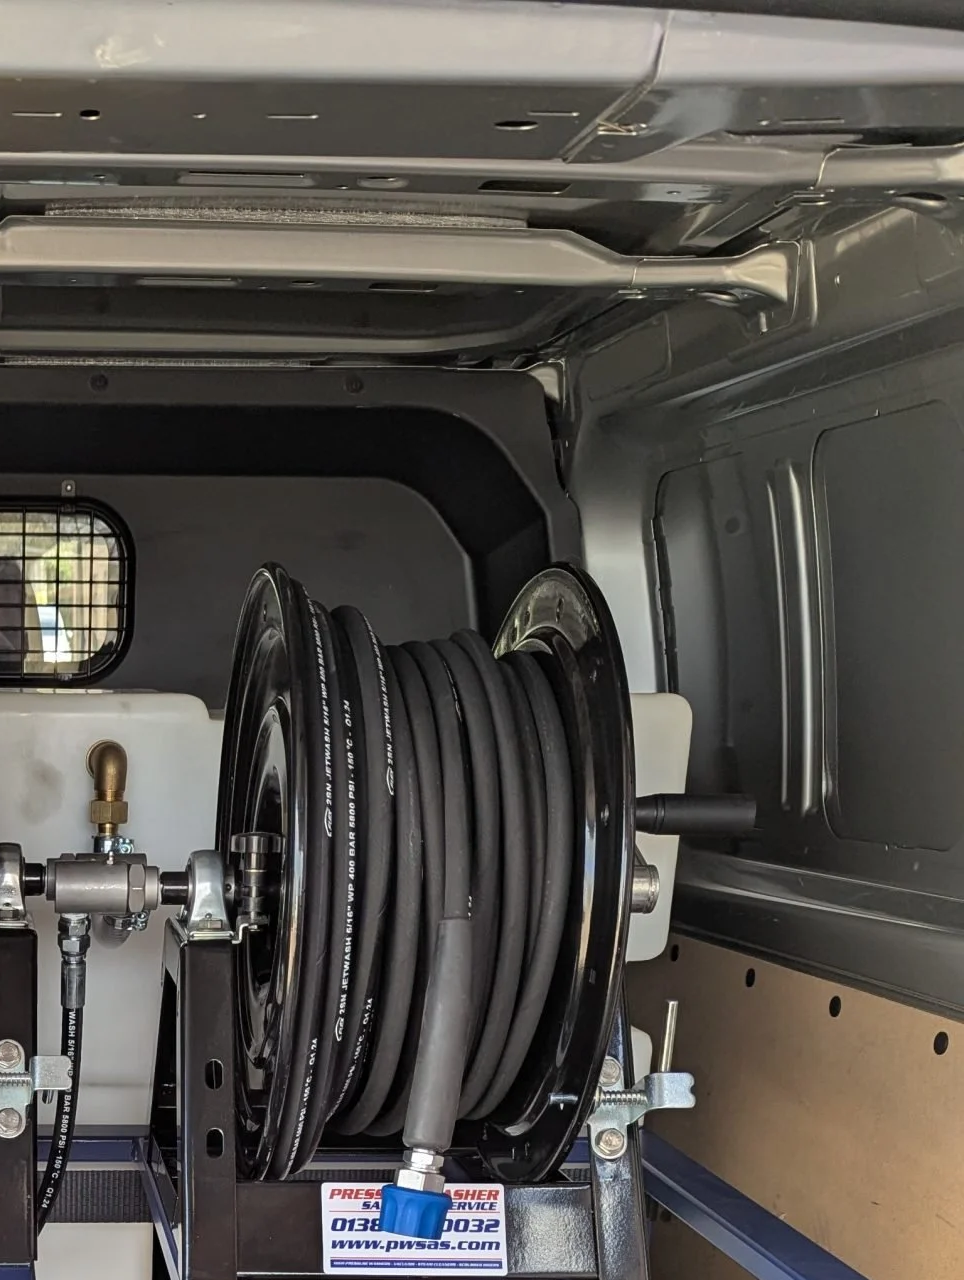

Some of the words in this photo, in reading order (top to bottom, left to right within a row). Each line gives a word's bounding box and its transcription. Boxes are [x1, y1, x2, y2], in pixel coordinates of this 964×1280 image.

[381, 693, 393, 742] JETWASH
[323, 727, 333, 781] JETWASH
[347, 752, 355, 770] 150
[348, 802, 356, 828] 5800
[348, 831, 356, 857] BAR
[348, 860, 356, 880] 400
[347, 883, 355, 902] WP
[341, 936, 353, 991] JETWASH
[339, 993, 347, 1015] 2SN
[68, 1008, 77, 1037] WASH
[63, 1094, 72, 1112] BAR
[60, 1114, 69, 1133] 5800
[58, 1134, 67, 1149] PSI
[54, 1155, 63, 1169] 150
[41, 1187, 54, 1209] Q1.24
[329, 1188, 383, 1200] PRESS
[451, 1201, 498, 1211] ERVICE
[331, 1217, 381, 1232] 0138
[442, 1218, 501, 1233] 0032
[331, 1239, 501, 1252] www.pwsas.com
